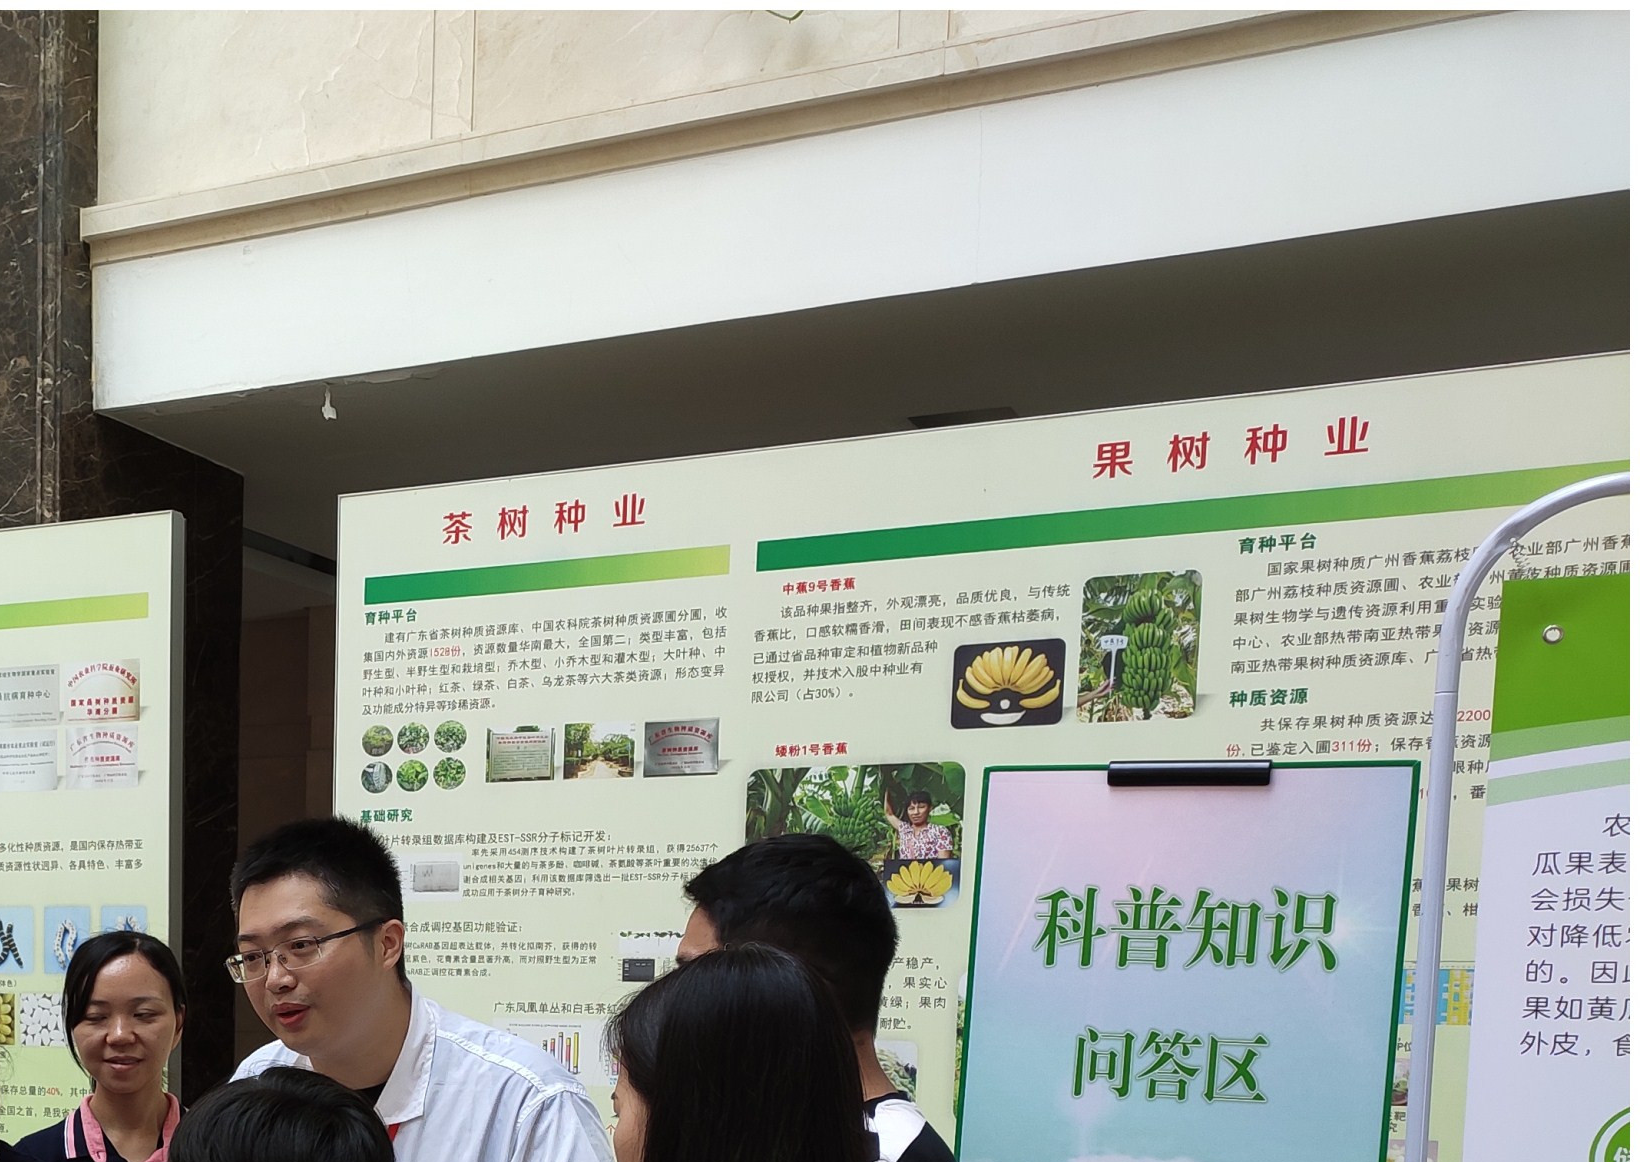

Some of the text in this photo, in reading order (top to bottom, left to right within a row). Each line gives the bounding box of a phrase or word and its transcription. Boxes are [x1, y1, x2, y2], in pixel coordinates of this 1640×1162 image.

[1090, 415, 1374, 484] 果树种业
[440, 490, 648, 547] 茶树种业
[1238, 531, 1318, 554] 育种平台
[781, 577, 857, 597] 中蕉9号香蕉
[365, 607, 418, 626] 育种平台
[1228, 687, 1309, 708] 种质资源
[361, 808, 413, 824] 基础研究
[1532, 849, 1628, 876] 瓜果表
[1529, 887, 1630, 914] 会损失
[1033, 884, 1339, 973] 科普知识
[1071, 1025, 1270, 1103] 问答区
